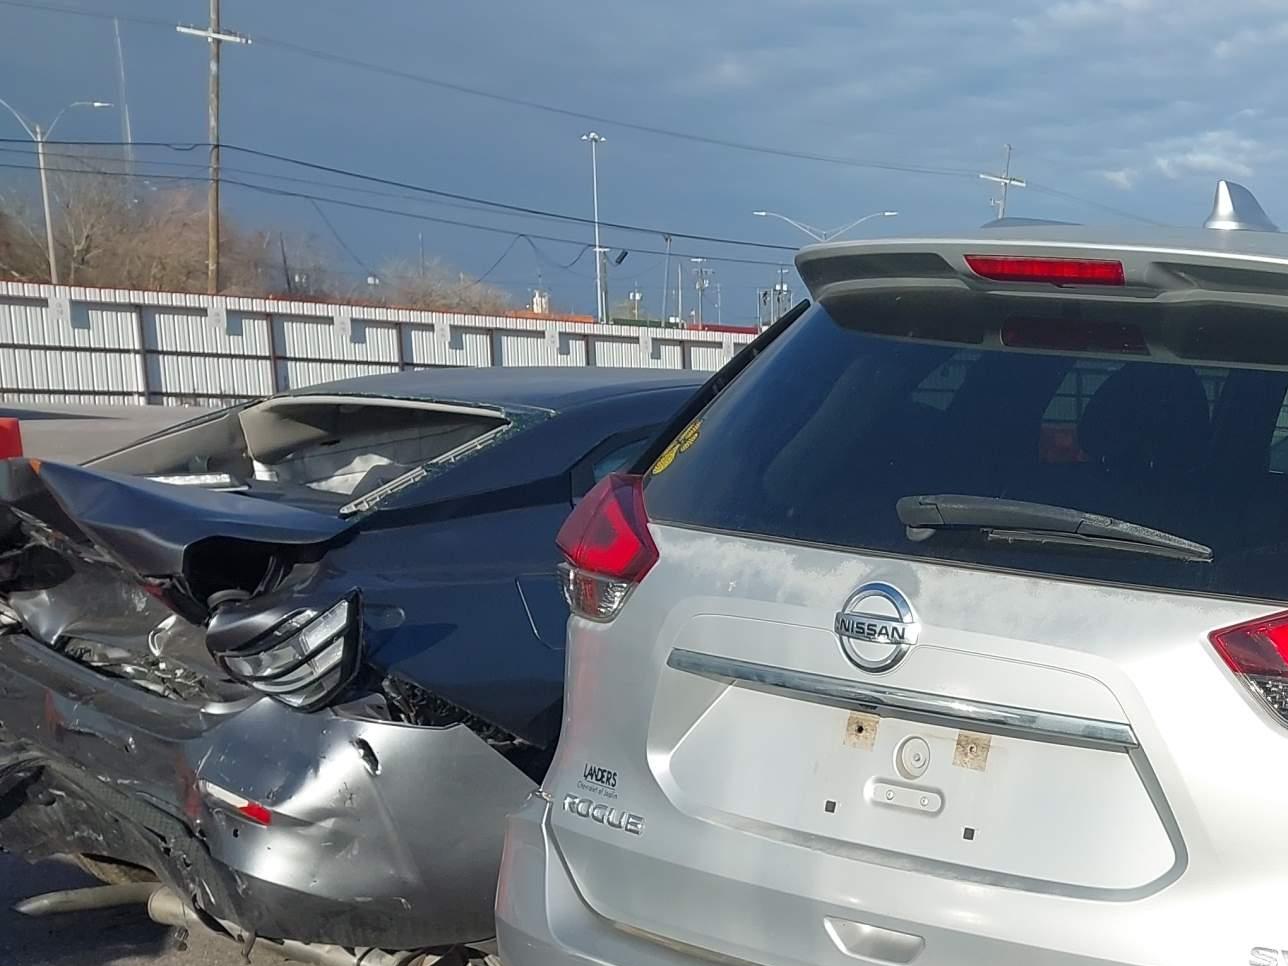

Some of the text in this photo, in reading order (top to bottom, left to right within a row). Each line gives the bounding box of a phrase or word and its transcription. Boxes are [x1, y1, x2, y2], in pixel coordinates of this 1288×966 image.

[840, 618, 906, 641] NISSAN
[583, 763, 618, 788] LANDERS
[563, 792, 644, 835] ROGUE
